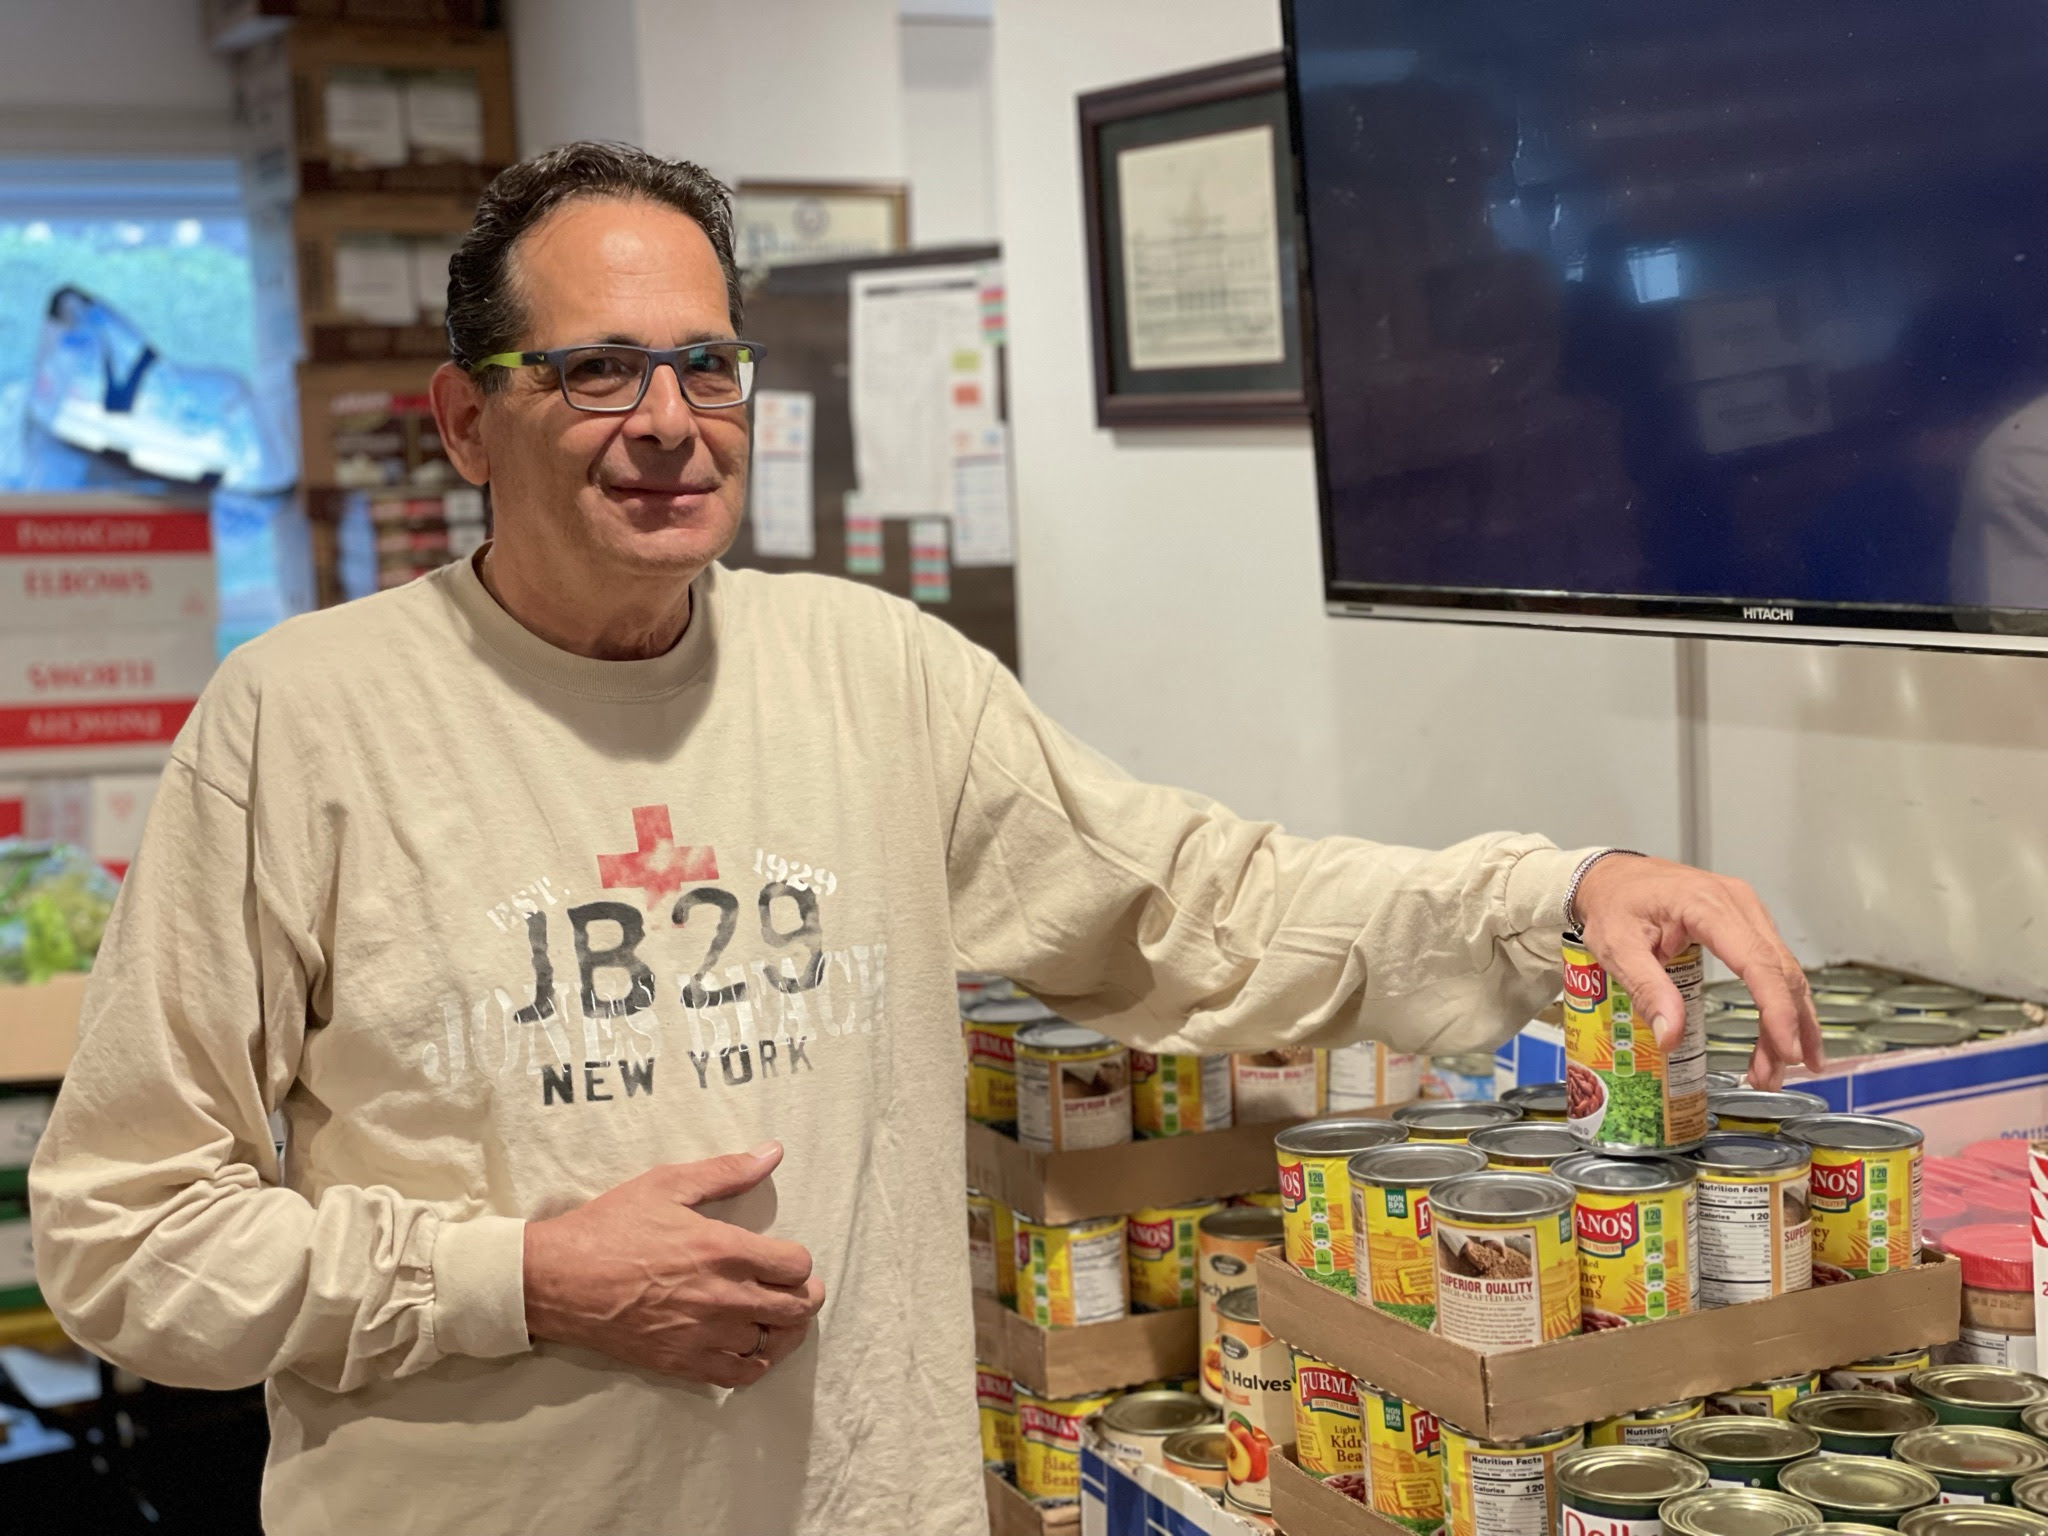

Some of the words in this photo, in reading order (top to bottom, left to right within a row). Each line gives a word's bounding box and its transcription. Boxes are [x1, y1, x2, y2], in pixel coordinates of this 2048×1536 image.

[1743, 606, 1794, 621] HITACHI
[487, 876, 570, 932] EST.
[752, 848, 837, 896] 1929
[513, 880, 823, 1024] JB29
[421, 974, 661, 1085] JONES
[677, 943, 887, 1059] BEACH
[543, 1057, 655, 1106] NEW
[688, 1035, 814, 1088] YORK
[1308, 1172, 1324, 1183] 120
[1871, 1168, 1888, 1178] 120
[1699, 1182, 1740, 1193] Nutrition
[1388, 1194, 1404, 1202] NON
[1388, 1201, 1405, 1209] BPA
[1645, 1209, 1660, 1220] 120
[1699, 1212, 1730, 1220] Calories
[1751, 1212, 1769, 1220] 120
[1440, 1273, 1482, 1293] SUPERIOR
[1486, 1281, 1533, 1294] QUALITY
[1505, 1294, 1533, 1302] BEANS
[1232, 1370, 1291, 1392] Halves
[1300, 1371, 1359, 1398] FURMA
[1386, 1406, 1401, 1415] NON
[1386, 1414, 1401, 1422] BPA
[1334, 1425, 1355, 1435] Light
[1472, 1456, 1513, 1465] Nutrition
[1516, 1457, 1542, 1465] Facts
[1474, 1485, 1505, 1493] Calories
[1525, 1484, 1544, 1493] 120
